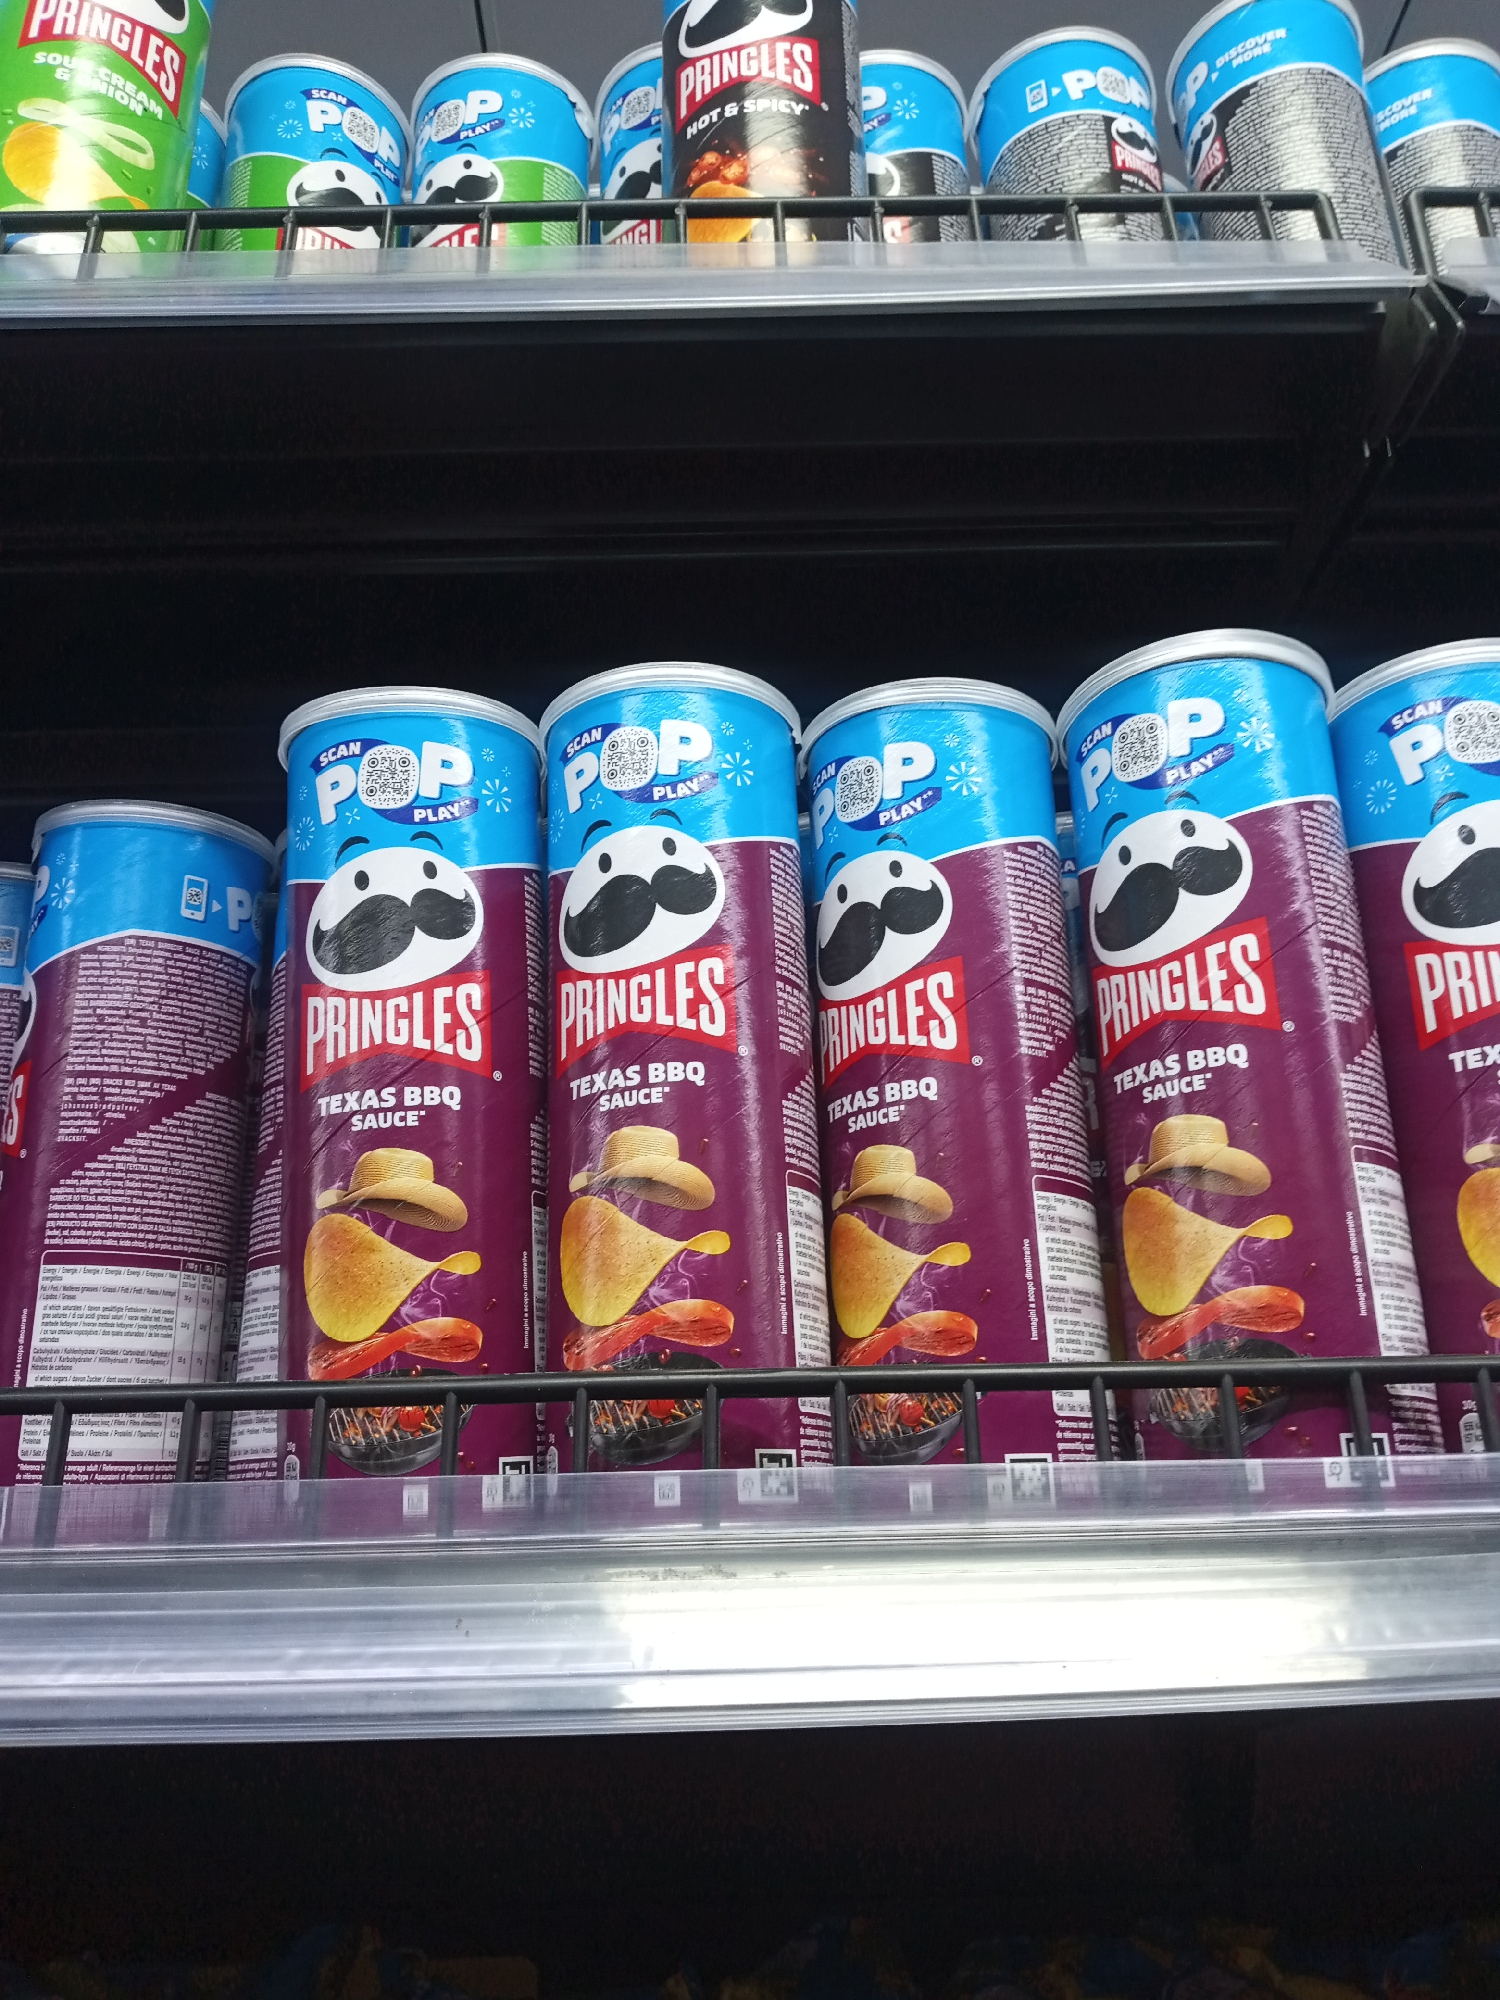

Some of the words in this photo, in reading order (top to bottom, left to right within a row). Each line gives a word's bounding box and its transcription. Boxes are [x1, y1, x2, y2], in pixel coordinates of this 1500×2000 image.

[28, 0, 185, 102] PRINGLES
[1215, 28, 1287, 68] DISCOVER
[1232, 42, 1272, 68] MORE
[54, 67, 71, 81] &
[679, 41, 813, 119] PRINGLES
[98, 66, 163, 120] CREAM
[311, 89, 348, 105] SCAN
[1376, 88, 1433, 123] SCOVER
[686, 108, 721, 139] HOT
[725, 102, 739, 117] &
[1391, 700, 1444, 732] SCAN
[319, 742, 362, 768] SCAN
[566, 727, 602, 758] SCAN
[1081, 721, 1113, 757] SCAN
[812, 762, 836, 796] SCAN
[560, 957, 727, 1061] PRINGLES
[1096, 932, 1267, 1057] PRINGLES
[306, 983, 483, 1076] PRINGLES
[819, 971, 958, 1085] PRINGLES
[570, 1065, 641, 1101] TEXAS
[648, 1061, 706, 1087] BBQ
[1113, 1054, 1181, 1094] TEXAS
[1187, 1043, 1249, 1069] BBQ
[317, 1087, 397, 1117] TEXAS
[403, 1086, 462, 1111] BBQ
[827, 1086, 880, 1124] TEXAS
[885, 1076, 938, 1102] BBQ
[777, 1232, 785, 1274] dimostrativo
[1023, 1239, 1033, 1280] dimostrativo
[779, 1274, 787, 1296] scopo
[1027, 1281, 1036, 1302] scopo
[18, 1308, 28, 1345] dimostrativo
[779, 1302, 788, 1335] Immagini
[1028, 1309, 1038, 1340] Immagini
[16, 1345, 24, 1363] scopo
